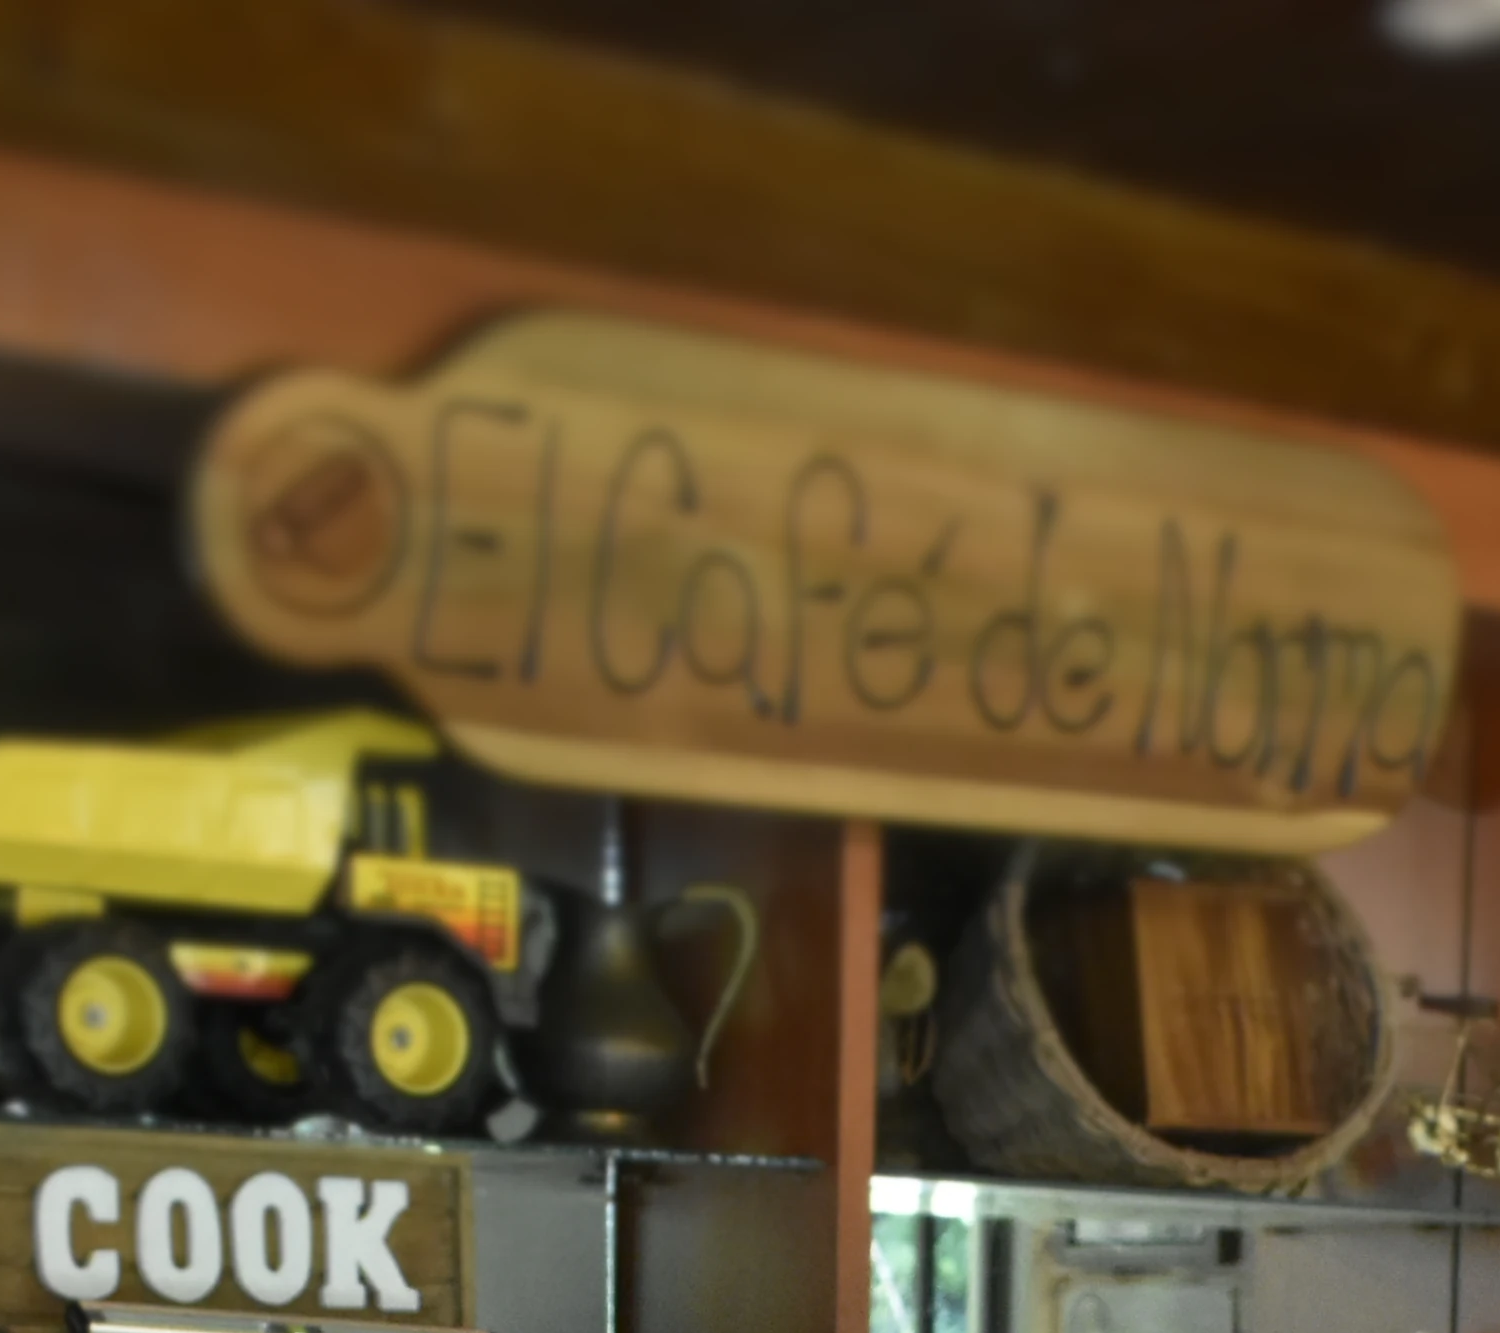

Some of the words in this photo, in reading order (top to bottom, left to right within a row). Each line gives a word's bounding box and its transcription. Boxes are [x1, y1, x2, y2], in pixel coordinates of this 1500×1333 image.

[413, 399, 562, 684] El
[591, 428, 962, 724] Café
[972, 488, 1114, 734] de
[33, 1163, 423, 1313] COOK
